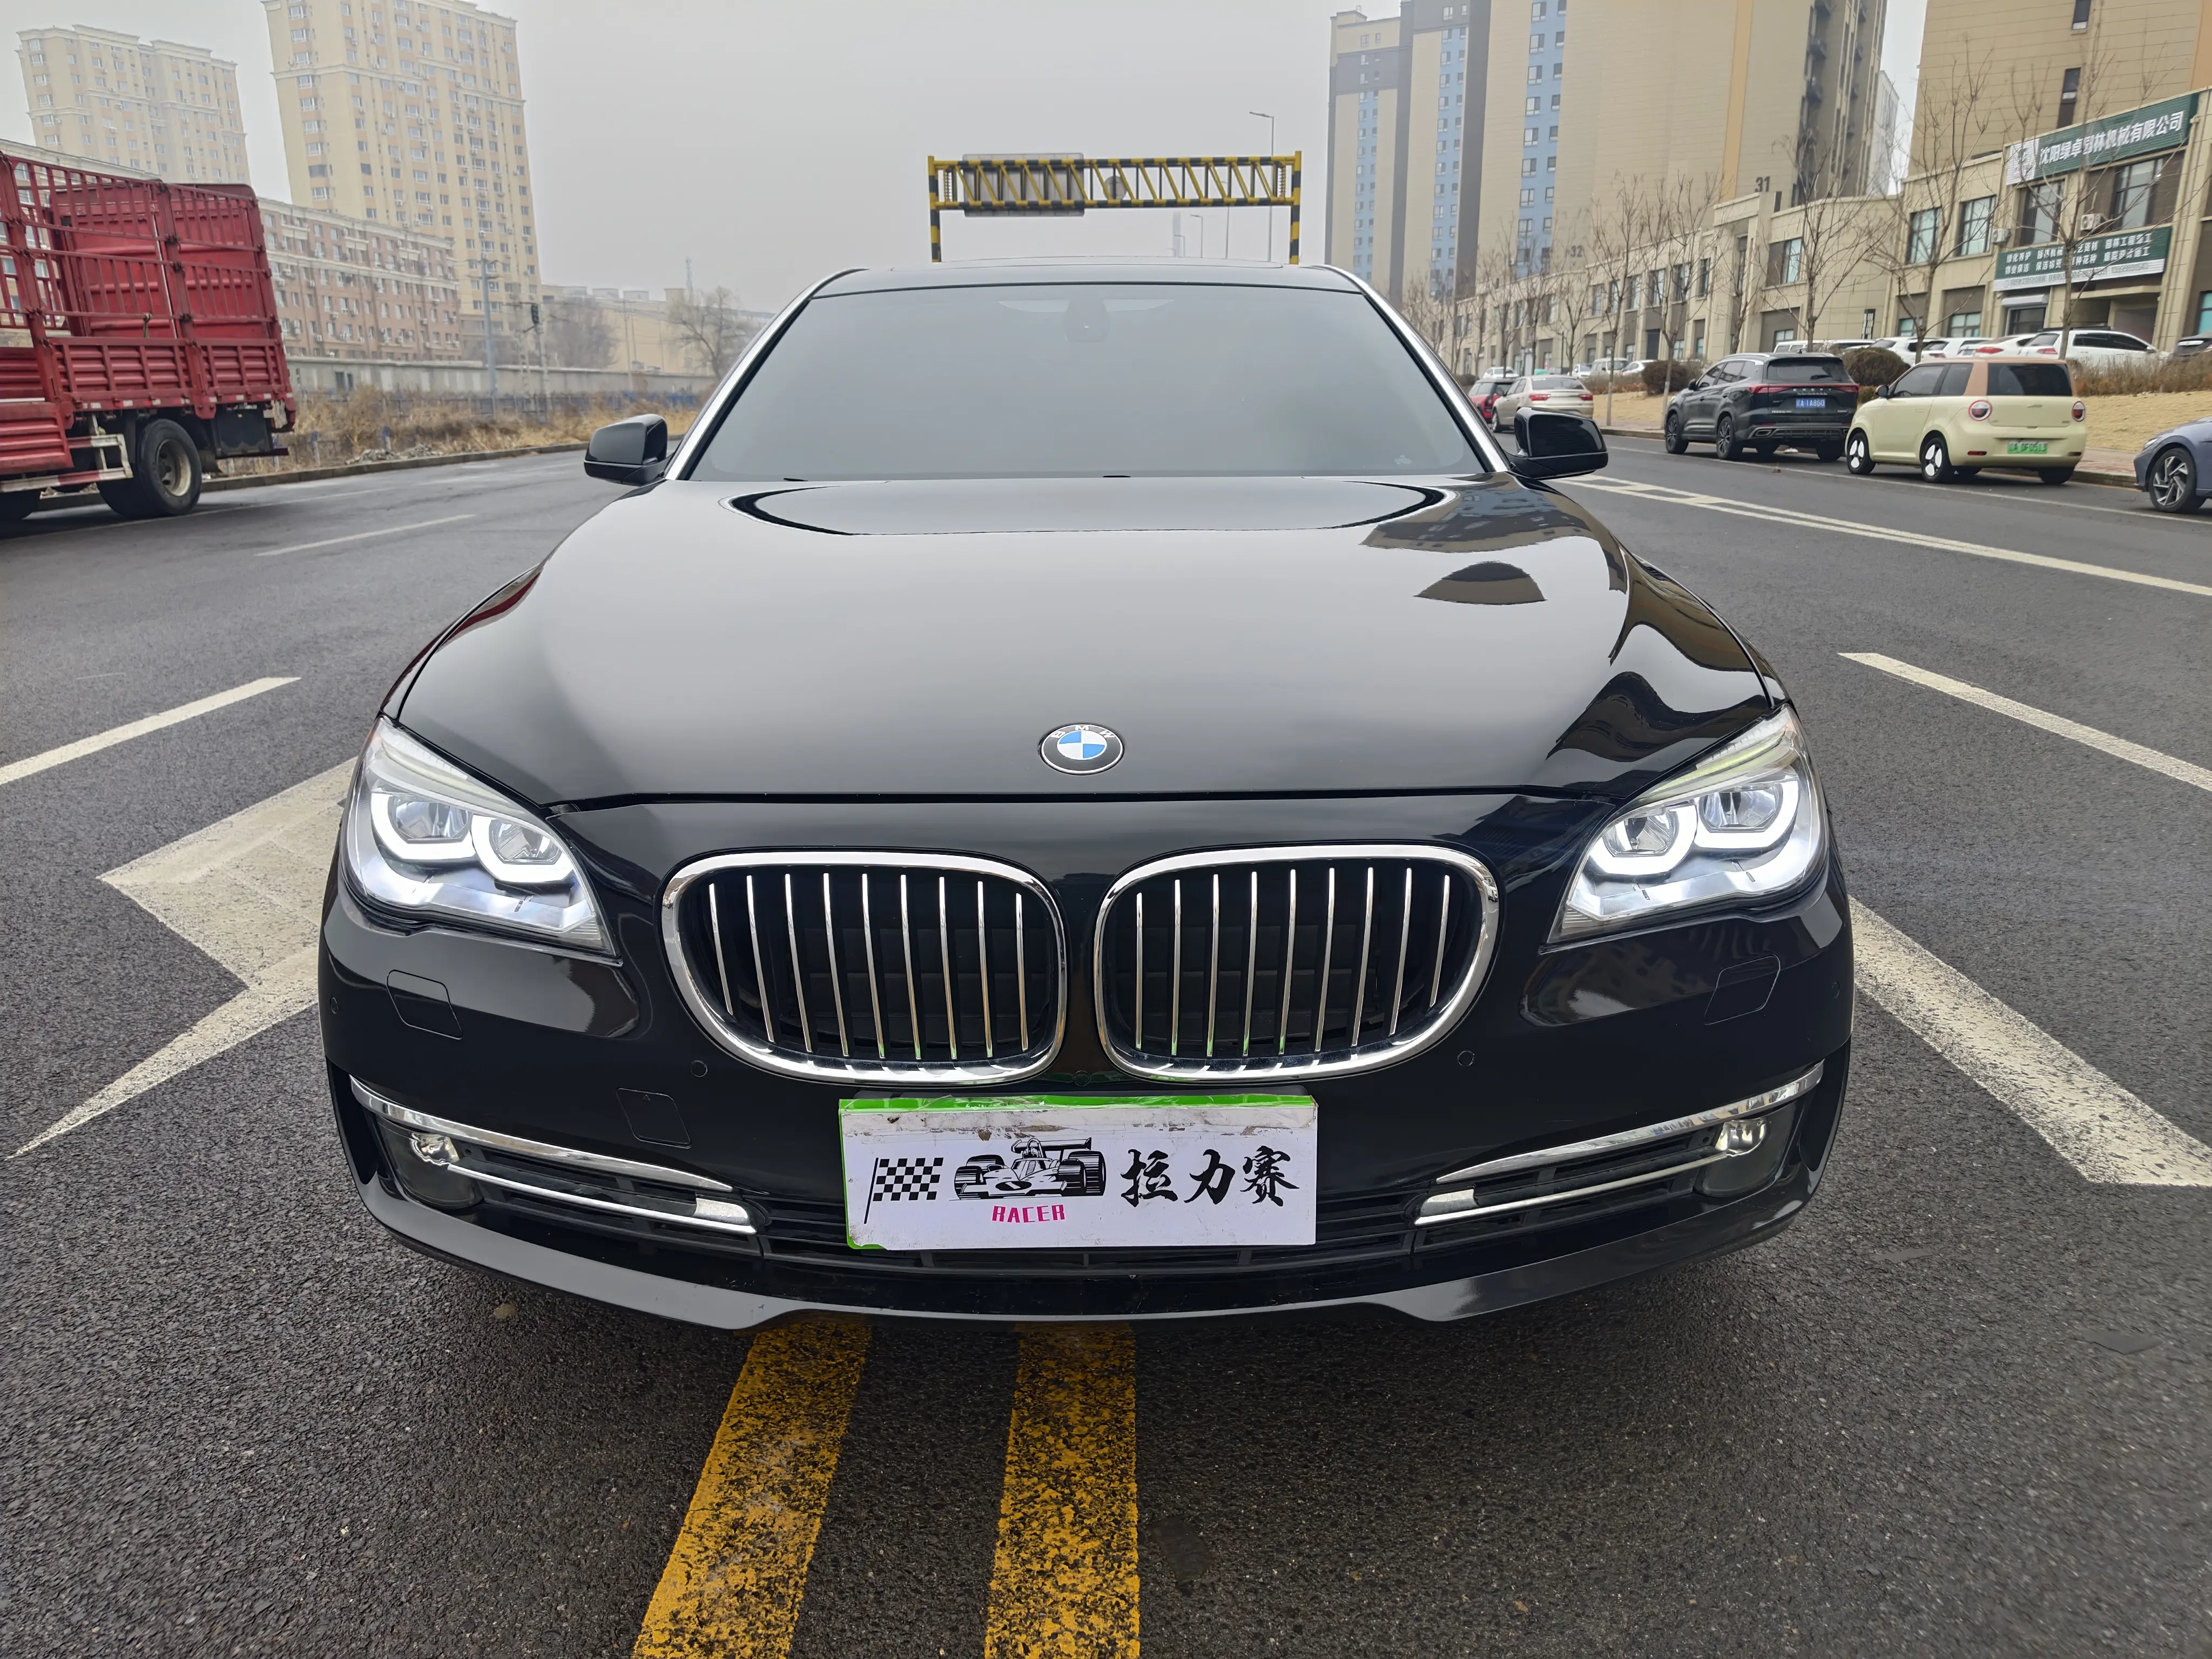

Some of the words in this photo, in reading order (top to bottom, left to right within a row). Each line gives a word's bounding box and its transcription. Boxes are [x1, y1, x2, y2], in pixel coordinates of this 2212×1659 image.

[1755, 176, 1770, 193] 31
[1570, 245, 1582, 257] 32
[1050, 725, 1115, 739] BMW
[1120, 1145, 1300, 1208] 拉力赛
[992, 1204, 1065, 1223] RACER
